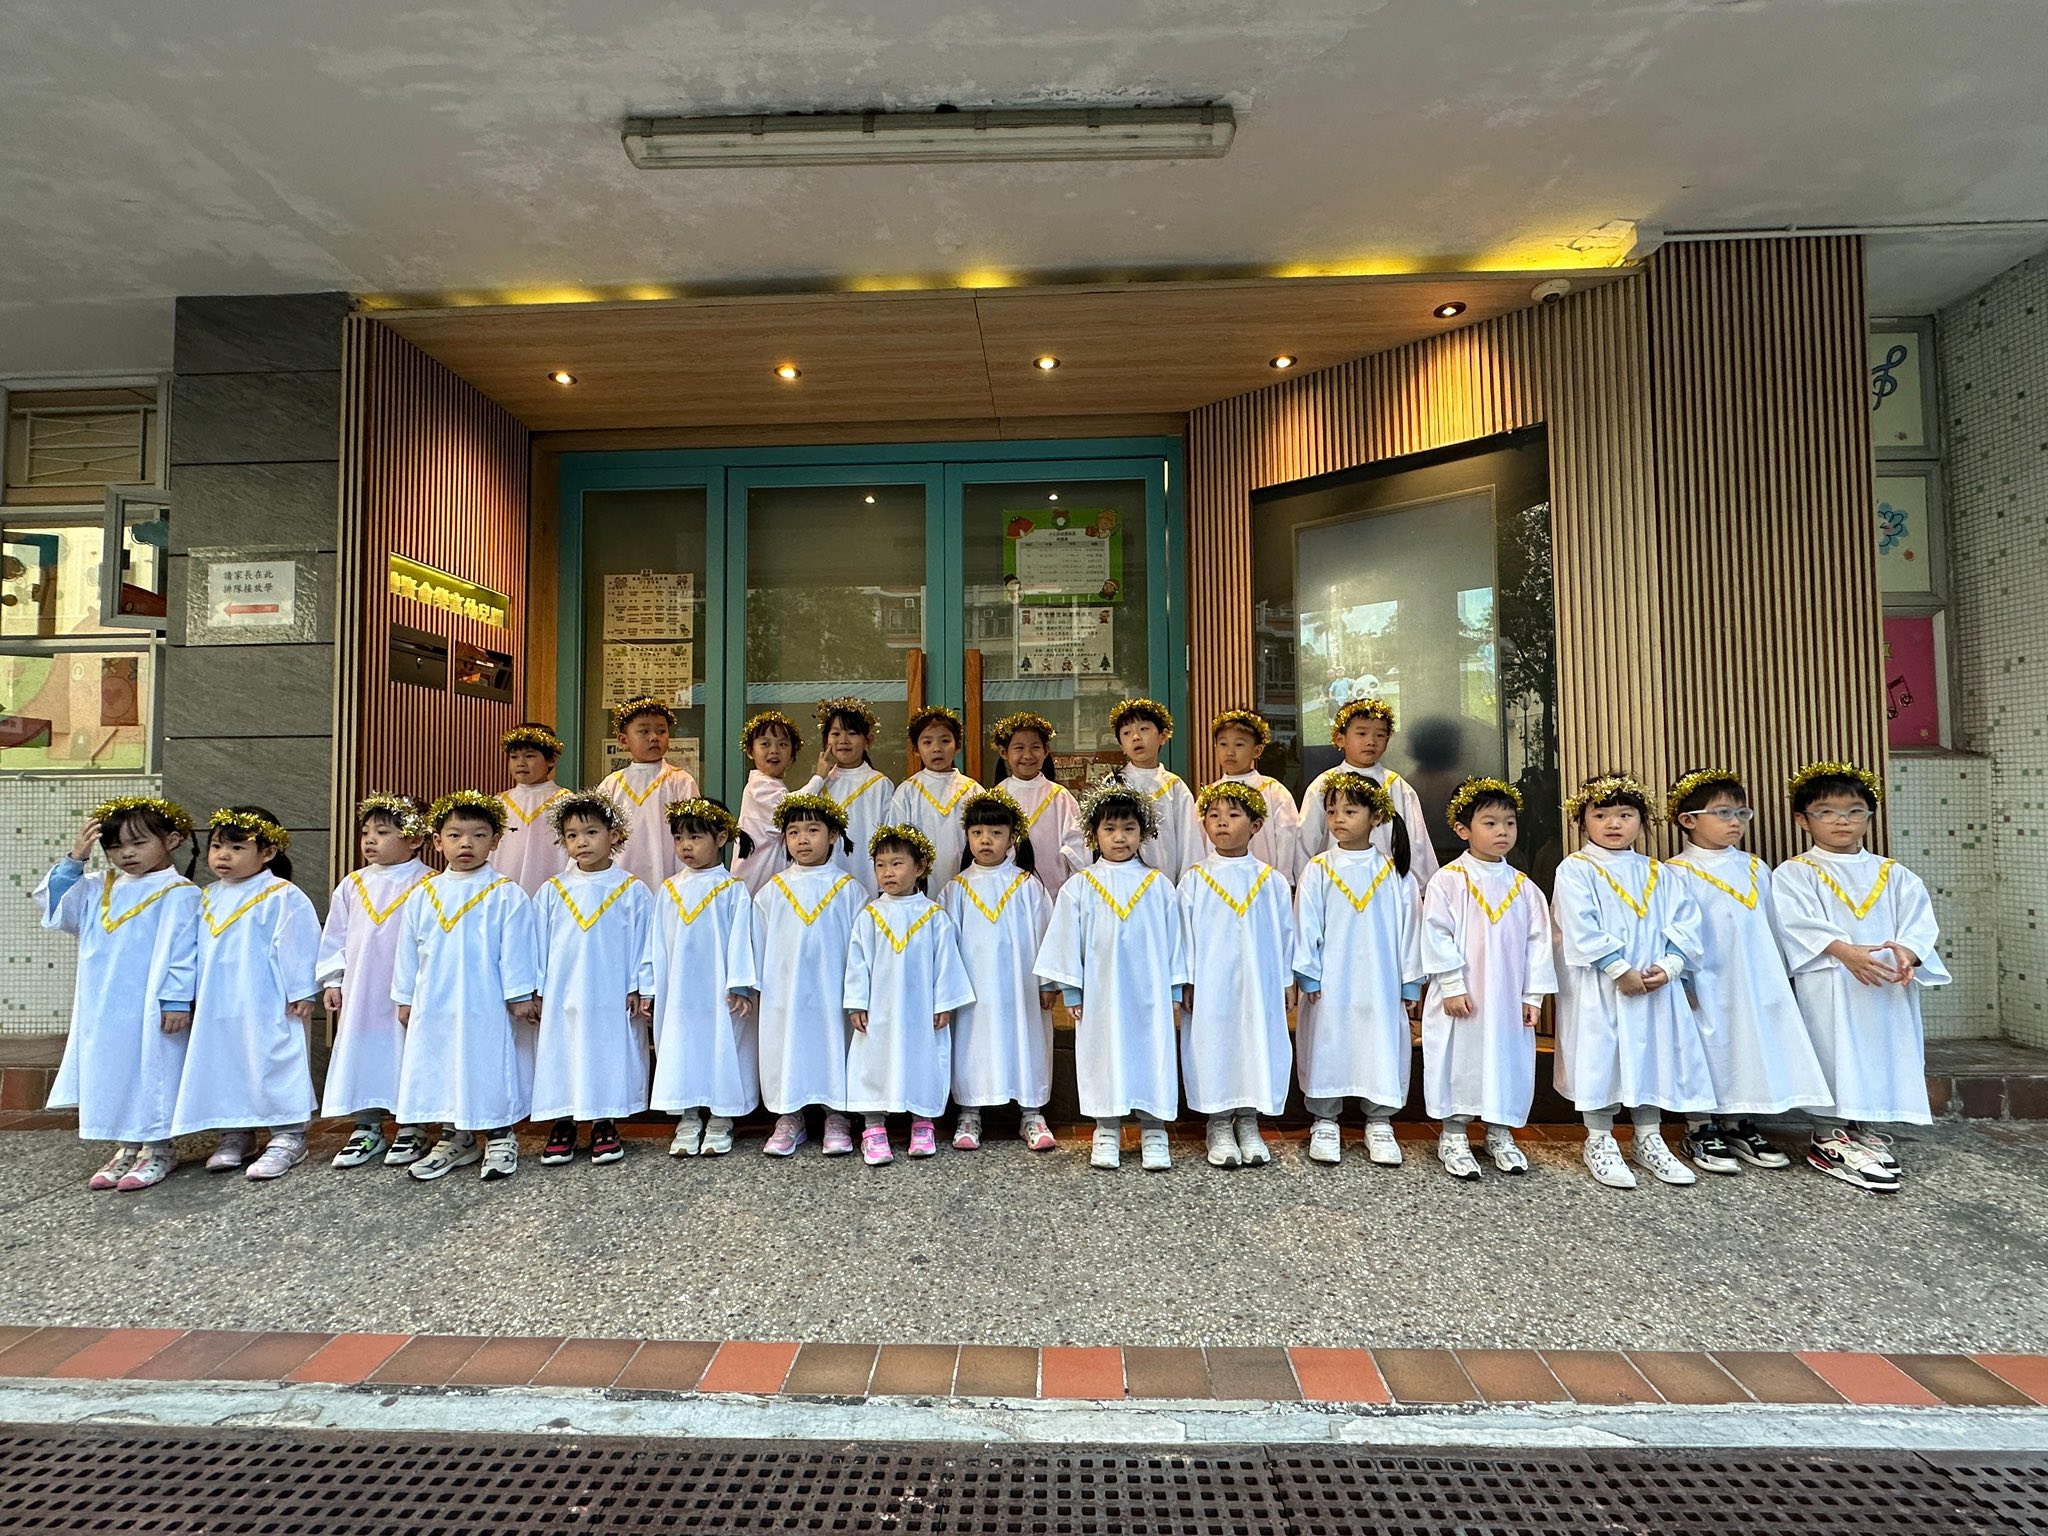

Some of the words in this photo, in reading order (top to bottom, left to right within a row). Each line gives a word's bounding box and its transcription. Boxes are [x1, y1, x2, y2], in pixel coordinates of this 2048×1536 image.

[223, 569, 274, 580] 請家長在此
[222, 583, 273, 593] 排隊接放學
